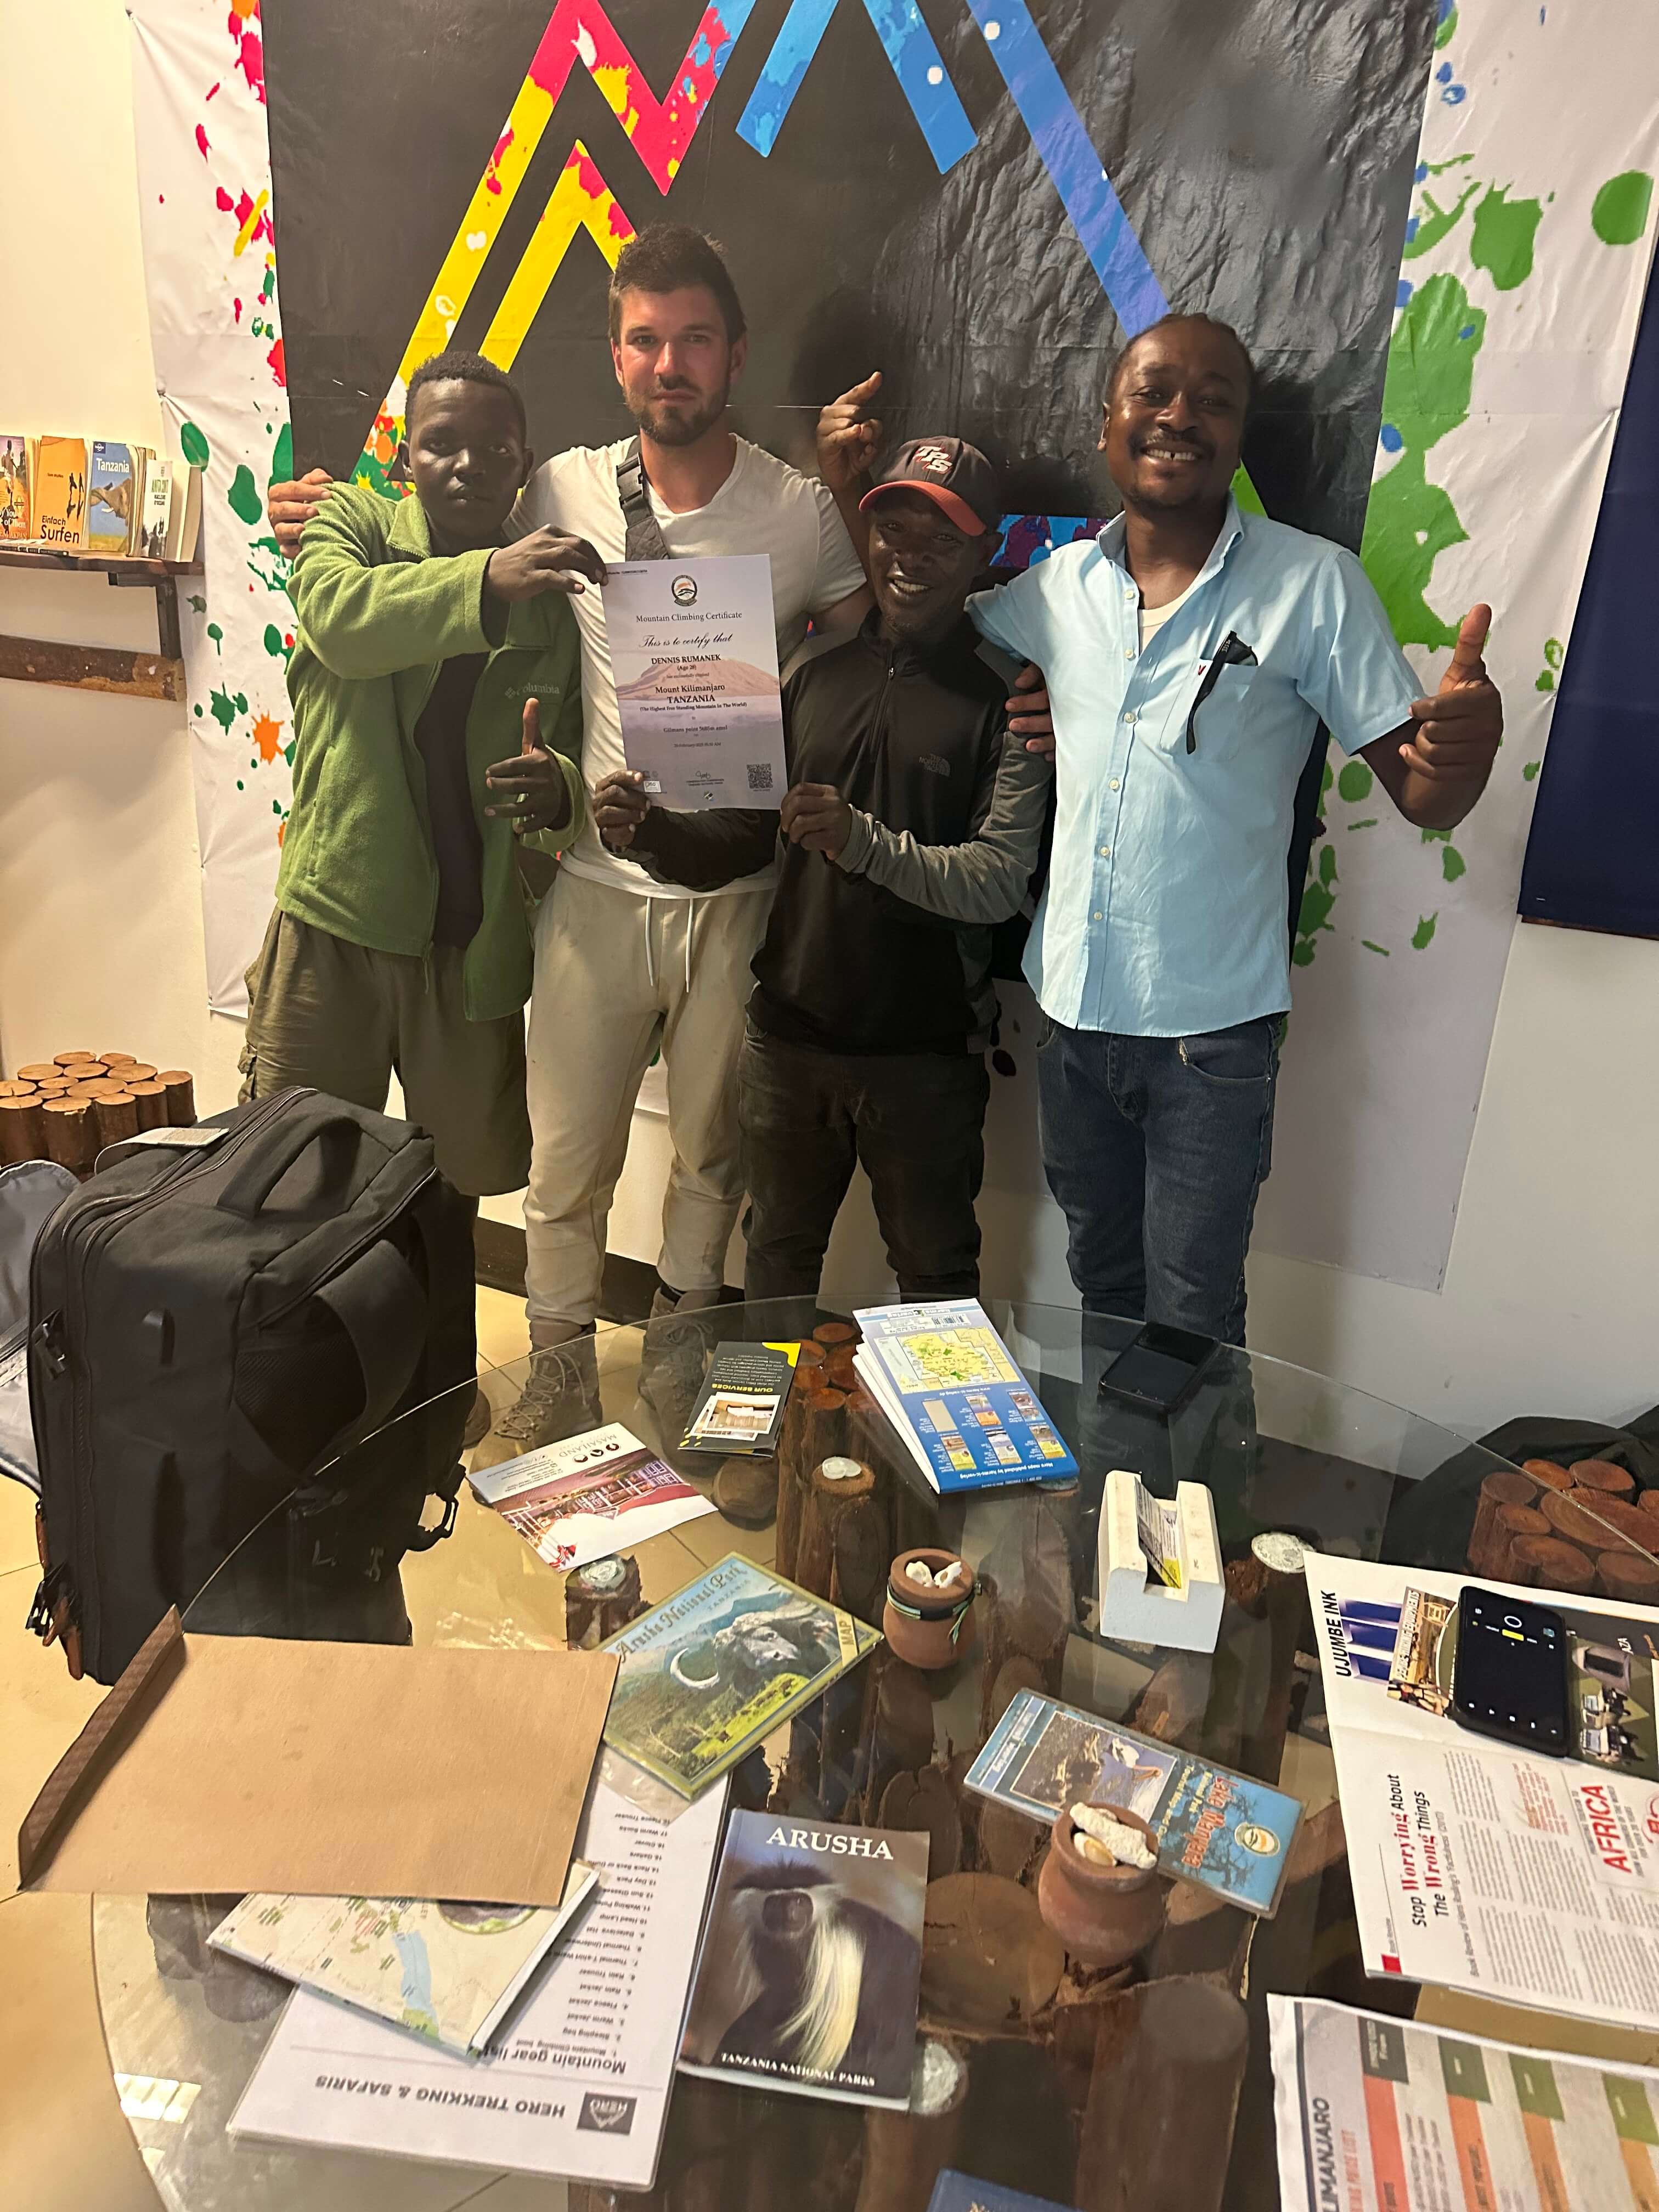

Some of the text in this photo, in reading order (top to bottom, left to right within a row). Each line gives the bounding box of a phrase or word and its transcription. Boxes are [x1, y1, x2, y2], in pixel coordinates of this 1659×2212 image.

[96, 457, 129, 473] Tanzania
[913, 445, 953, 474] TPS
[42, 515, 66, 525] Einfach
[40, 525, 80, 544] Surfen
[672, 613, 704, 622] Climbing
[706, 611, 742, 620] Certificate
[639, 635, 661, 648] This
[673, 637, 680, 645] to
[682, 633, 710, 649] certify
[713, 632, 733, 642] that
[682, 654, 721, 662] RUMANEK
[681, 684, 725, 693] Kilimanjaro
[667, 695, 715, 703] TANZANIA
[712, 1383, 751, 1392] SERVICES
[559, 1434, 617, 1458] MASAILAND
[616, 1565, 748, 1663] Arusha National Park
[840, 1620, 855, 1645] MAP
[1321, 1590, 1352, 1677] UJUMBE INK
[1181, 1776, 1239, 1869] Lake Manyara
[1581, 1785, 1632, 1874] AFRICA
[766, 1827, 894, 1860] ARUSHA
[1387, 1774, 1427, 1928] Stop Worrying About
[1414, 1791, 1449, 1917] The Wrong Things
[614, 1903, 641, 1911] Walking
[600, 1956, 627, 1965] Thermal
[579, 1968, 606, 1978] Trouser
[569, 1997, 593, 2005] Jacket
[567, 2013, 591, 2021] Jacket
[537, 2040, 571, 2051] Climbing
[572, 2045, 606, 2056] Mountain
[511, 2049, 548, 2062] gear
[552, 2052, 627, 2074] Mountain
[721, 2052, 876, 2087] TANZANIA NATIONAL PARKS
[316, 2074, 566, 2119] HERO TREKKING & SAFARIS
[590, 2097, 628, 2111] HERO
[1312, 2096, 1340, 2212] LIMANJARO
